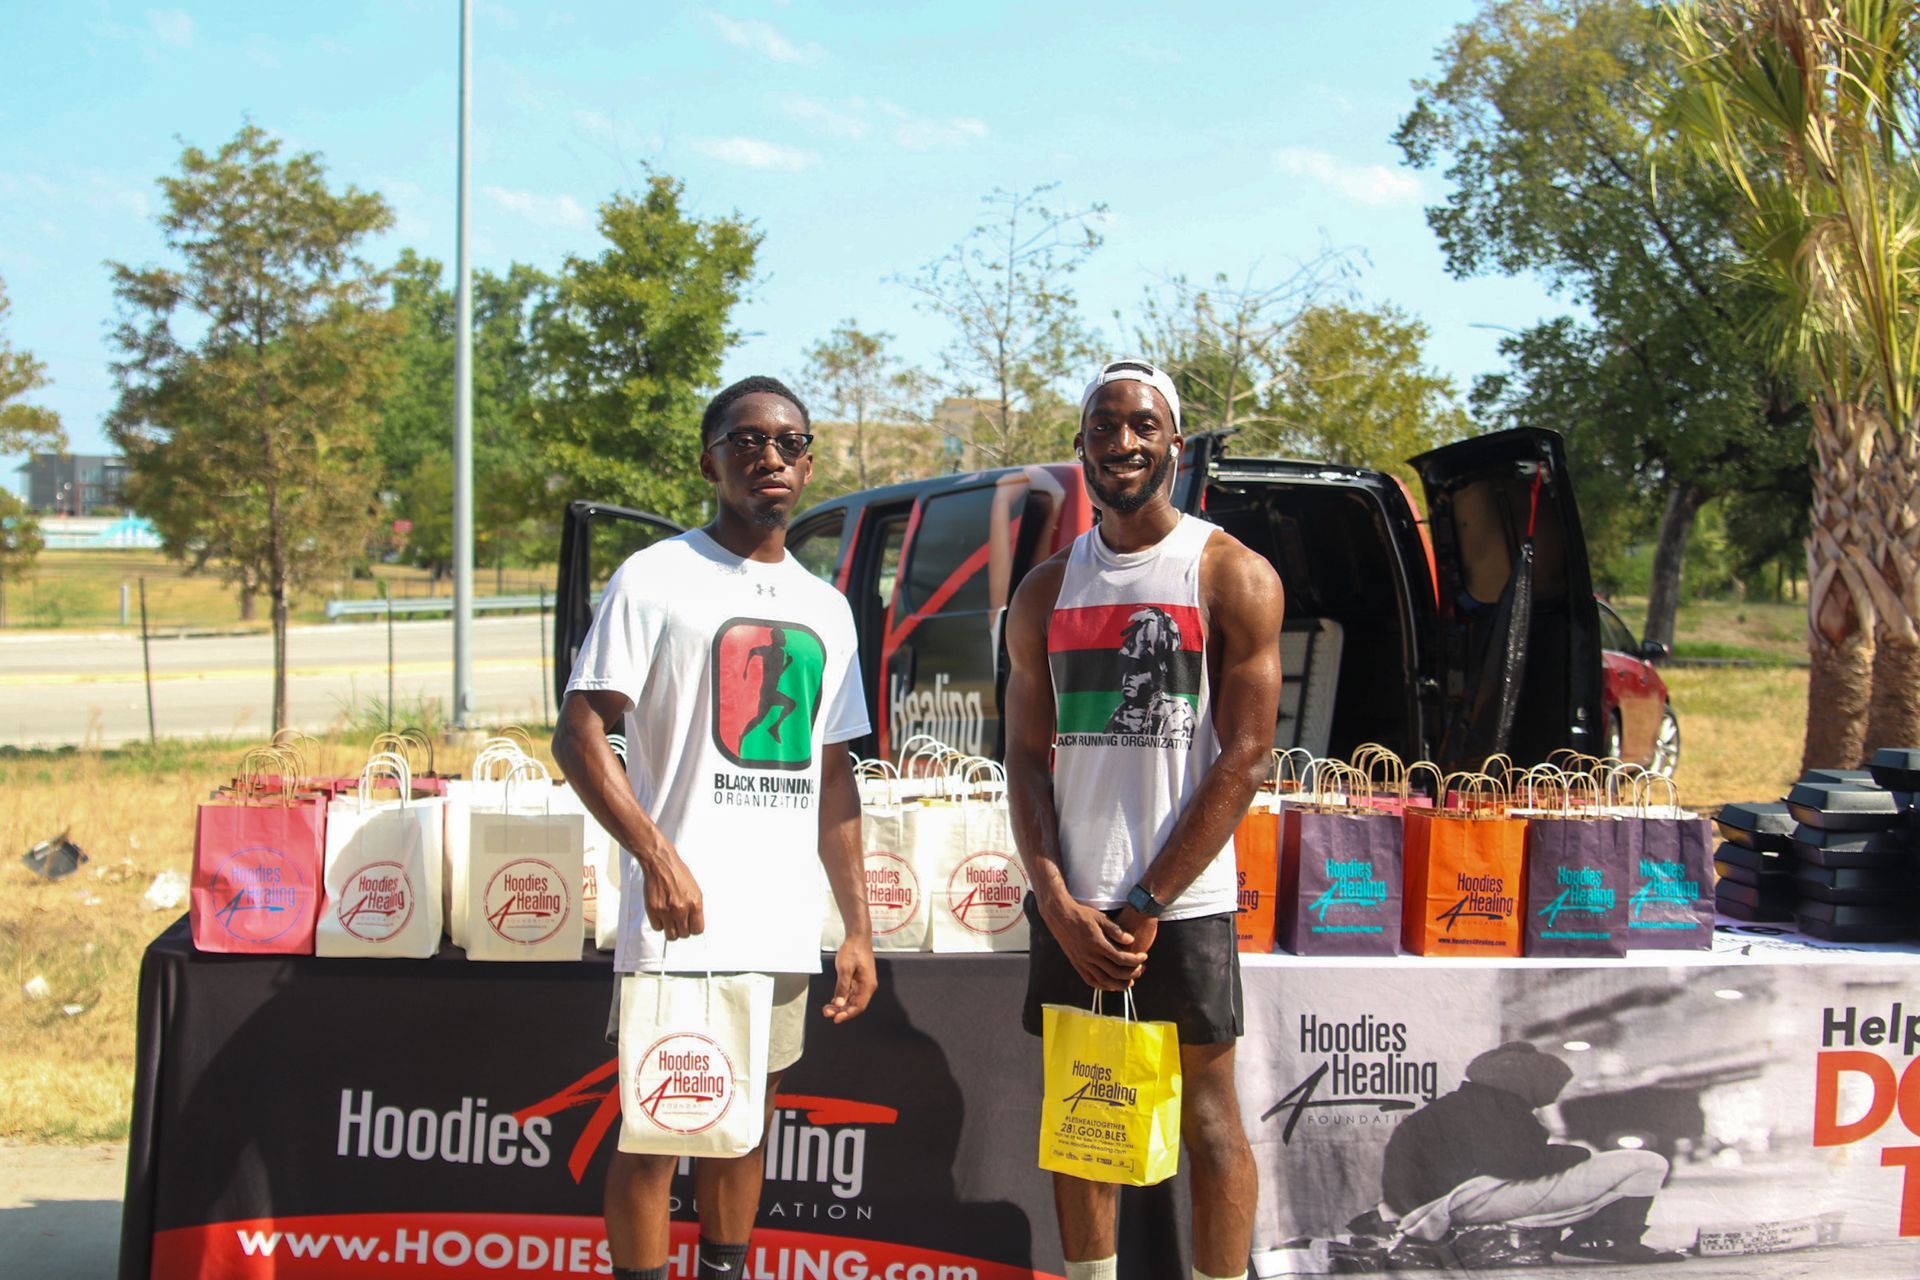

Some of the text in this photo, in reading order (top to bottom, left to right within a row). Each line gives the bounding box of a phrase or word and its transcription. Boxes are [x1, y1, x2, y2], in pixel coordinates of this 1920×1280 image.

[890, 673, 984, 757] Healing
[714, 773, 755, 792] BLACK
[865, 867, 900, 885] oodies
[966, 867, 1008, 885] Hoodies
[1325, 859, 1373, 879] Hoodies
[1558, 866, 1603, 886] Hoodies
[359, 875, 398, 892] Hoodies
[504, 874, 548, 892] Hoodies
[979, 883, 1021, 904] Healing
[1339, 877, 1387, 902] Healing
[1457, 873, 1503, 893] Hoodies
[516, 892, 560, 914] Healing
[870, 884, 912, 906] Healing
[1469, 892, 1513, 917] Healing
[1570, 886, 1615, 909] Healing
[1300, 1014, 1407, 1053] Hoodies
[659, 1050, 710, 1071] Hoodies
[1072, 1060, 1112, 1081] Hoodies
[673, 1071, 724, 1098] Healing
[1332, 1053, 1438, 1104] Healing
[1090, 1080, 1137, 1106] Healing
[337, 1088, 552, 1168] Hoodies
[1307, 1114, 1408, 1125] FOUNDATI
